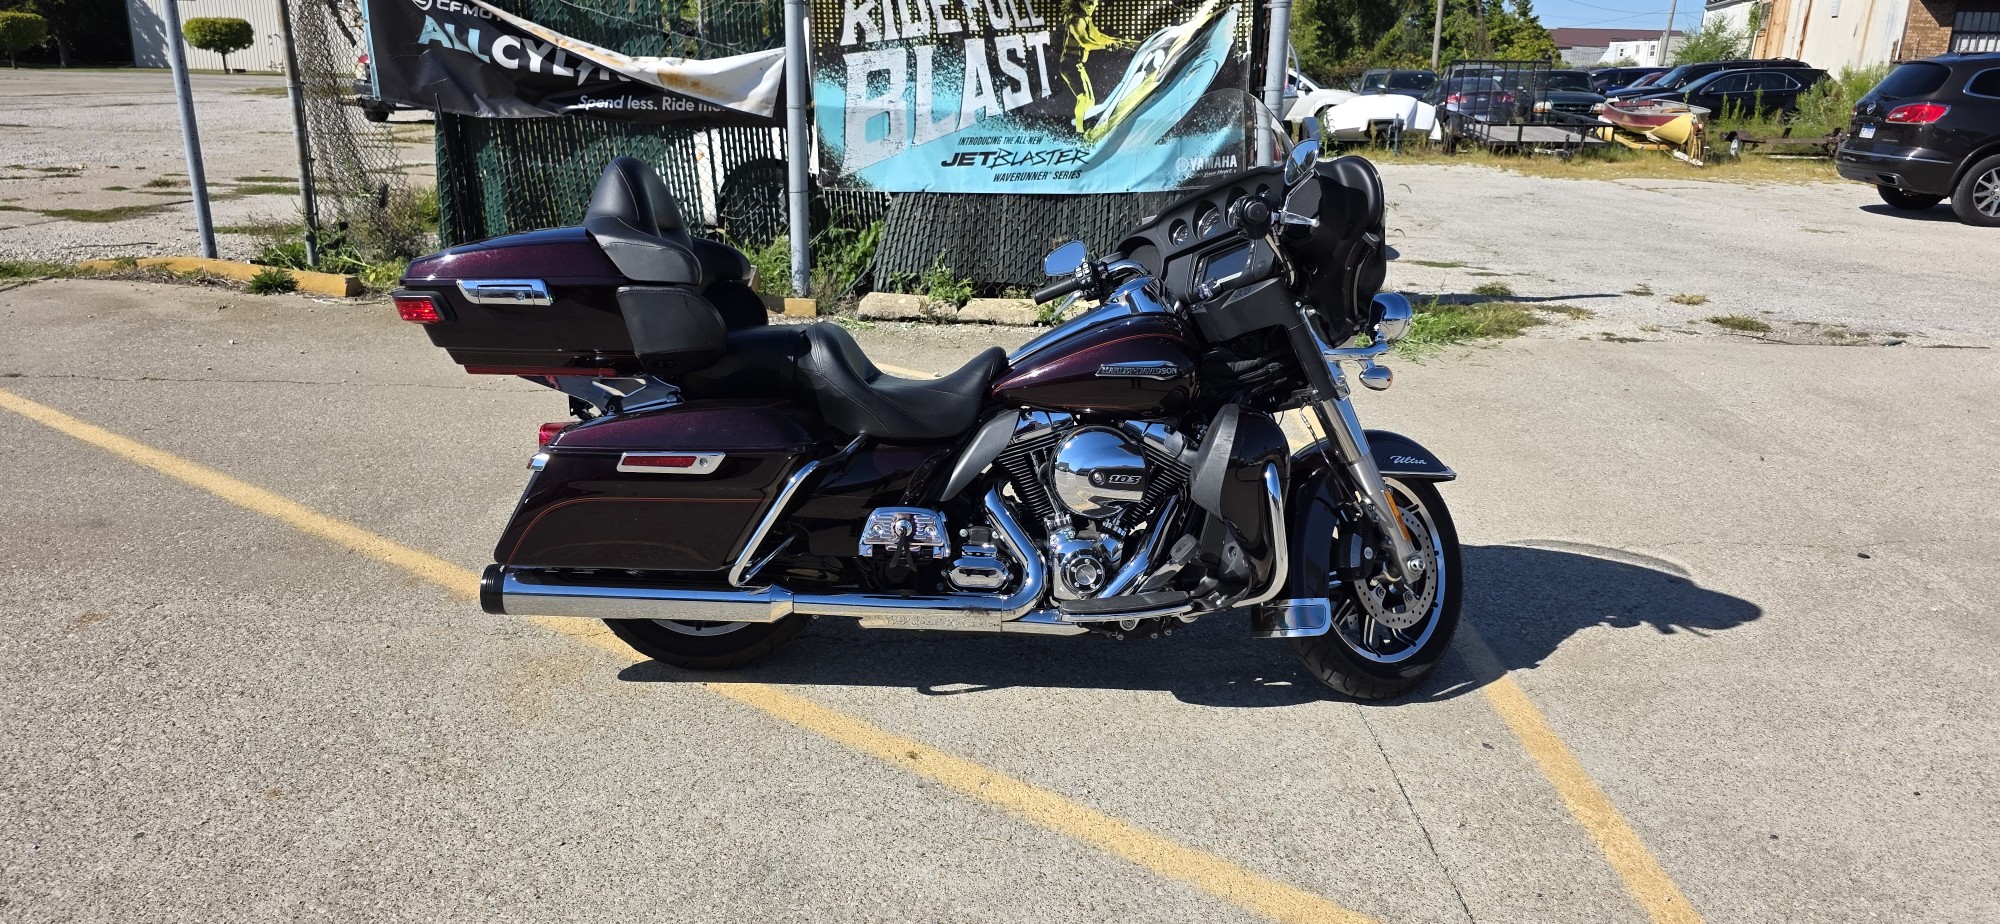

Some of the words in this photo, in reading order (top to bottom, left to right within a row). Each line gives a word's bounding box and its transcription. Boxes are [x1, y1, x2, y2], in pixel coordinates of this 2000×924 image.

[436, 0, 501, 21] CFMO
[580, 95, 623, 110] Spend
[627, 95, 658, 111] less.
[662, 96, 695, 111] Ride
[841, 31, 1052, 175] BLAST
[958, 136, 1001, 146] INTRODUCING
[1003, 137, 1013, 145] THE
[1015, 136, 1044, 145] ALL-NEW
[1189, 154, 1238, 171] YAMAHA
[1053, 170, 1083, 180] SERIES
[1101, 366, 1178, 375] HARLEY-DAVIDSON
[1390, 455, 1427, 465] Ultra
[1109, 474, 1142, 484] 103
